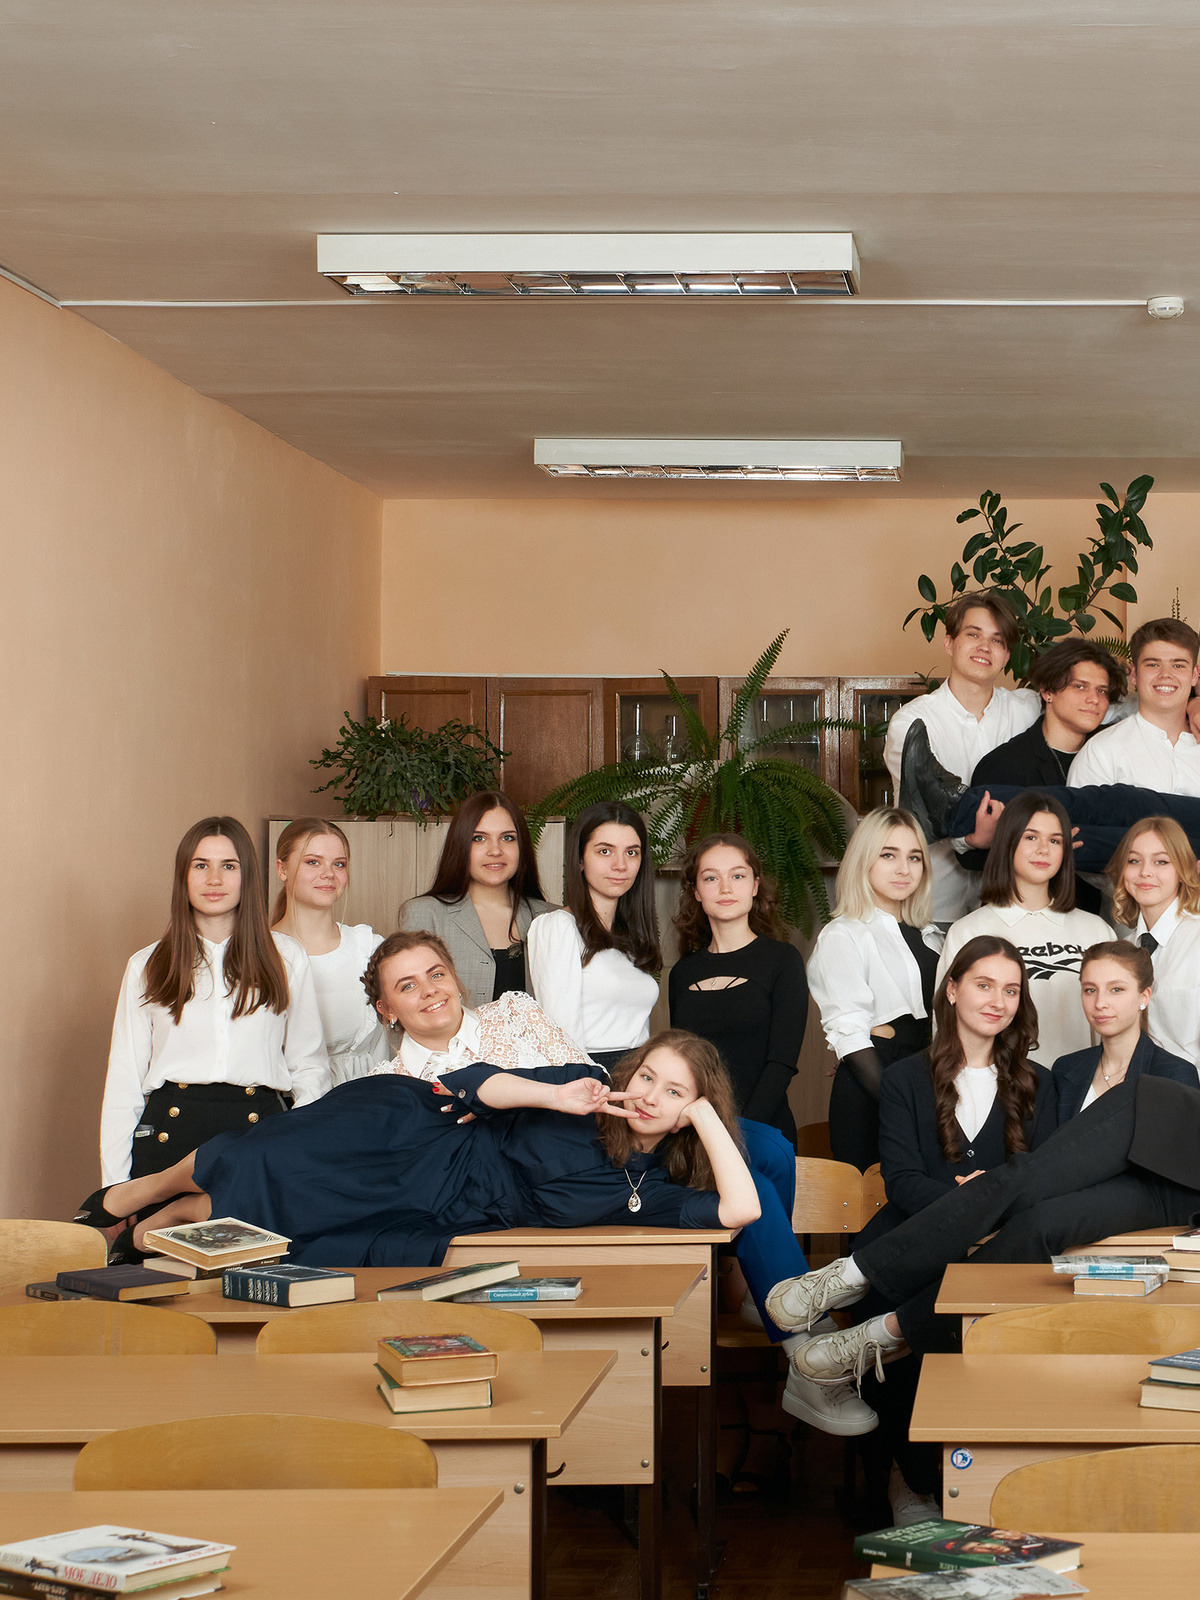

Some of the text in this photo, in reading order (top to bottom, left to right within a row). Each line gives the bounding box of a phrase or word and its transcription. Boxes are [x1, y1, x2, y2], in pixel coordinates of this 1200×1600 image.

[1017, 942, 1087, 957] eebo
[63, 1566, 118, 1589] МОЕ ДЕЛО
